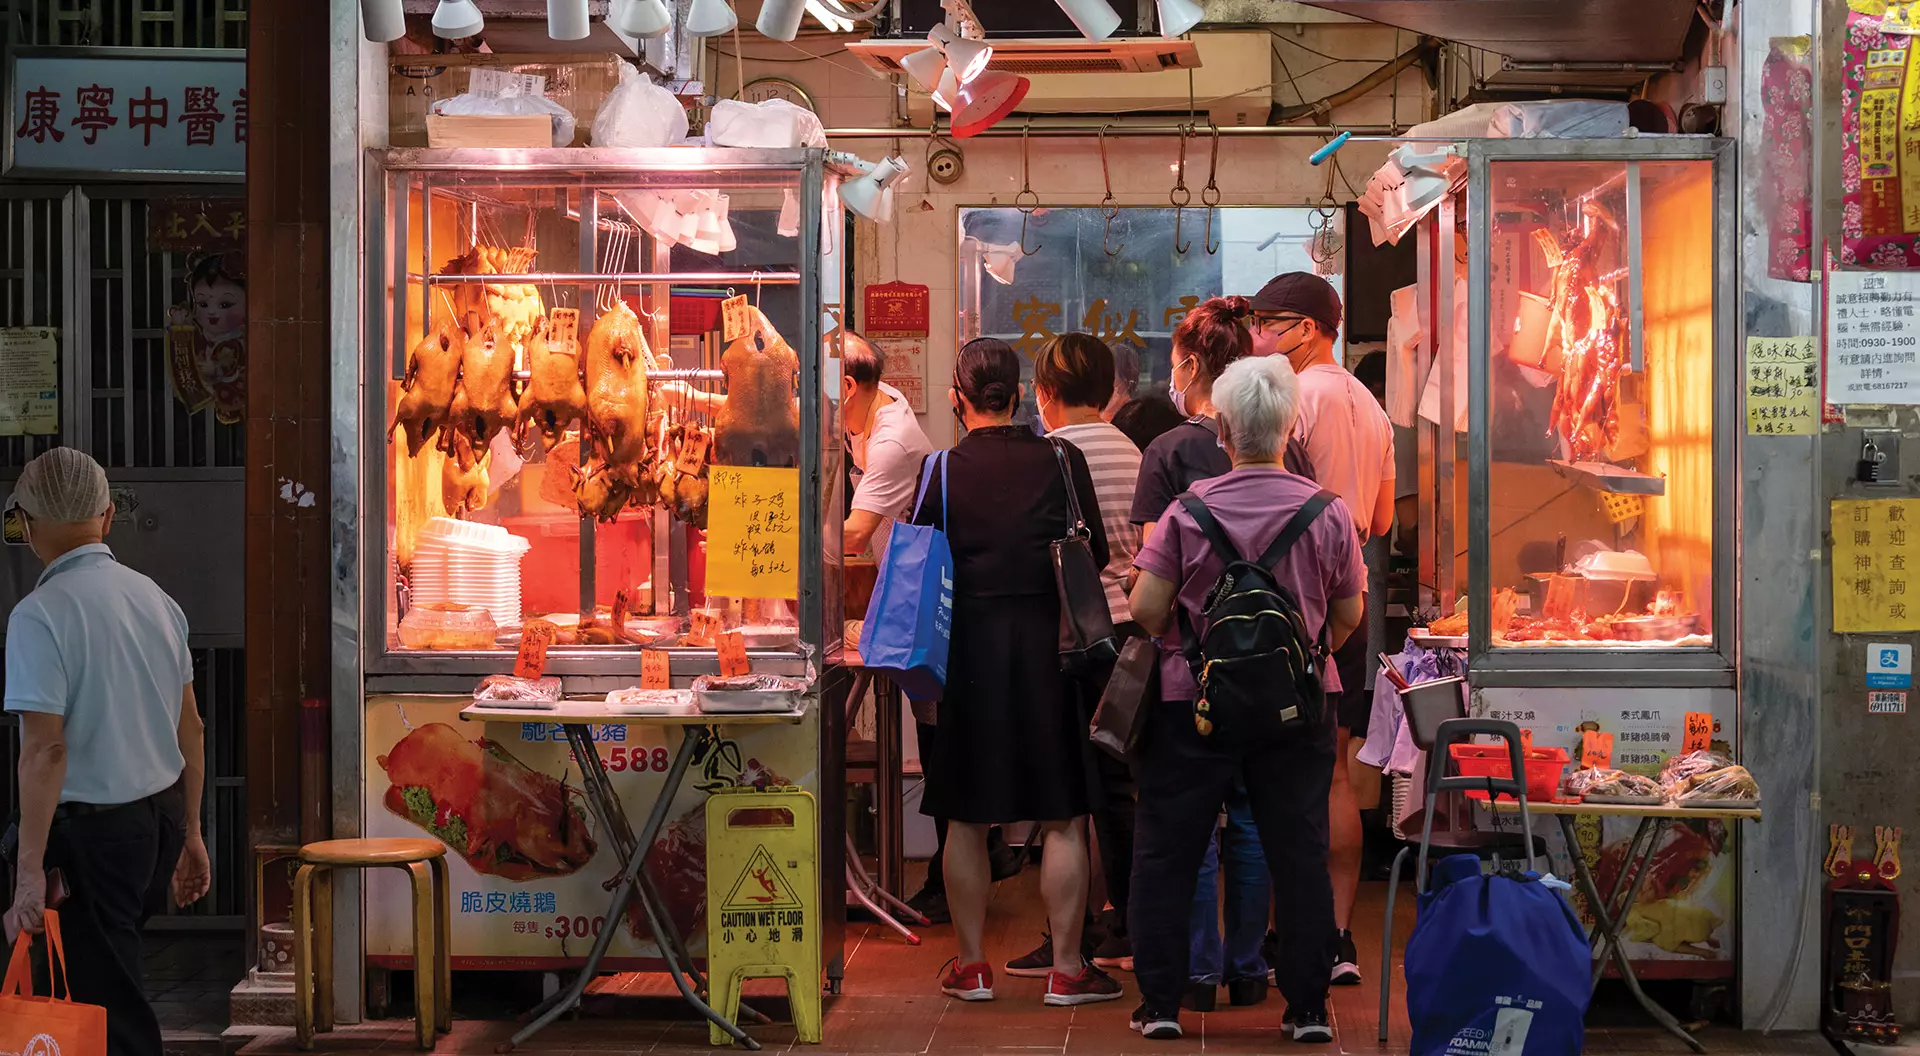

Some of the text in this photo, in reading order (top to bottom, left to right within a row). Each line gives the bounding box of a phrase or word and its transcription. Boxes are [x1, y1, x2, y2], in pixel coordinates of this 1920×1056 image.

[766, 89, 779, 99] 12
[1854, 506, 1871, 596] 訂購神樓
[1888, 505, 1906, 620] 歡迎查詢或
[521, 722, 628, 743] 馳名豬
[460, 891, 557, 914] 脆皮燒鵝
[512, 920, 540, 934] 每隻
[721, 910, 804, 928] CAUTION WET FLOOR
[723, 927, 803, 944] 小心地滑
